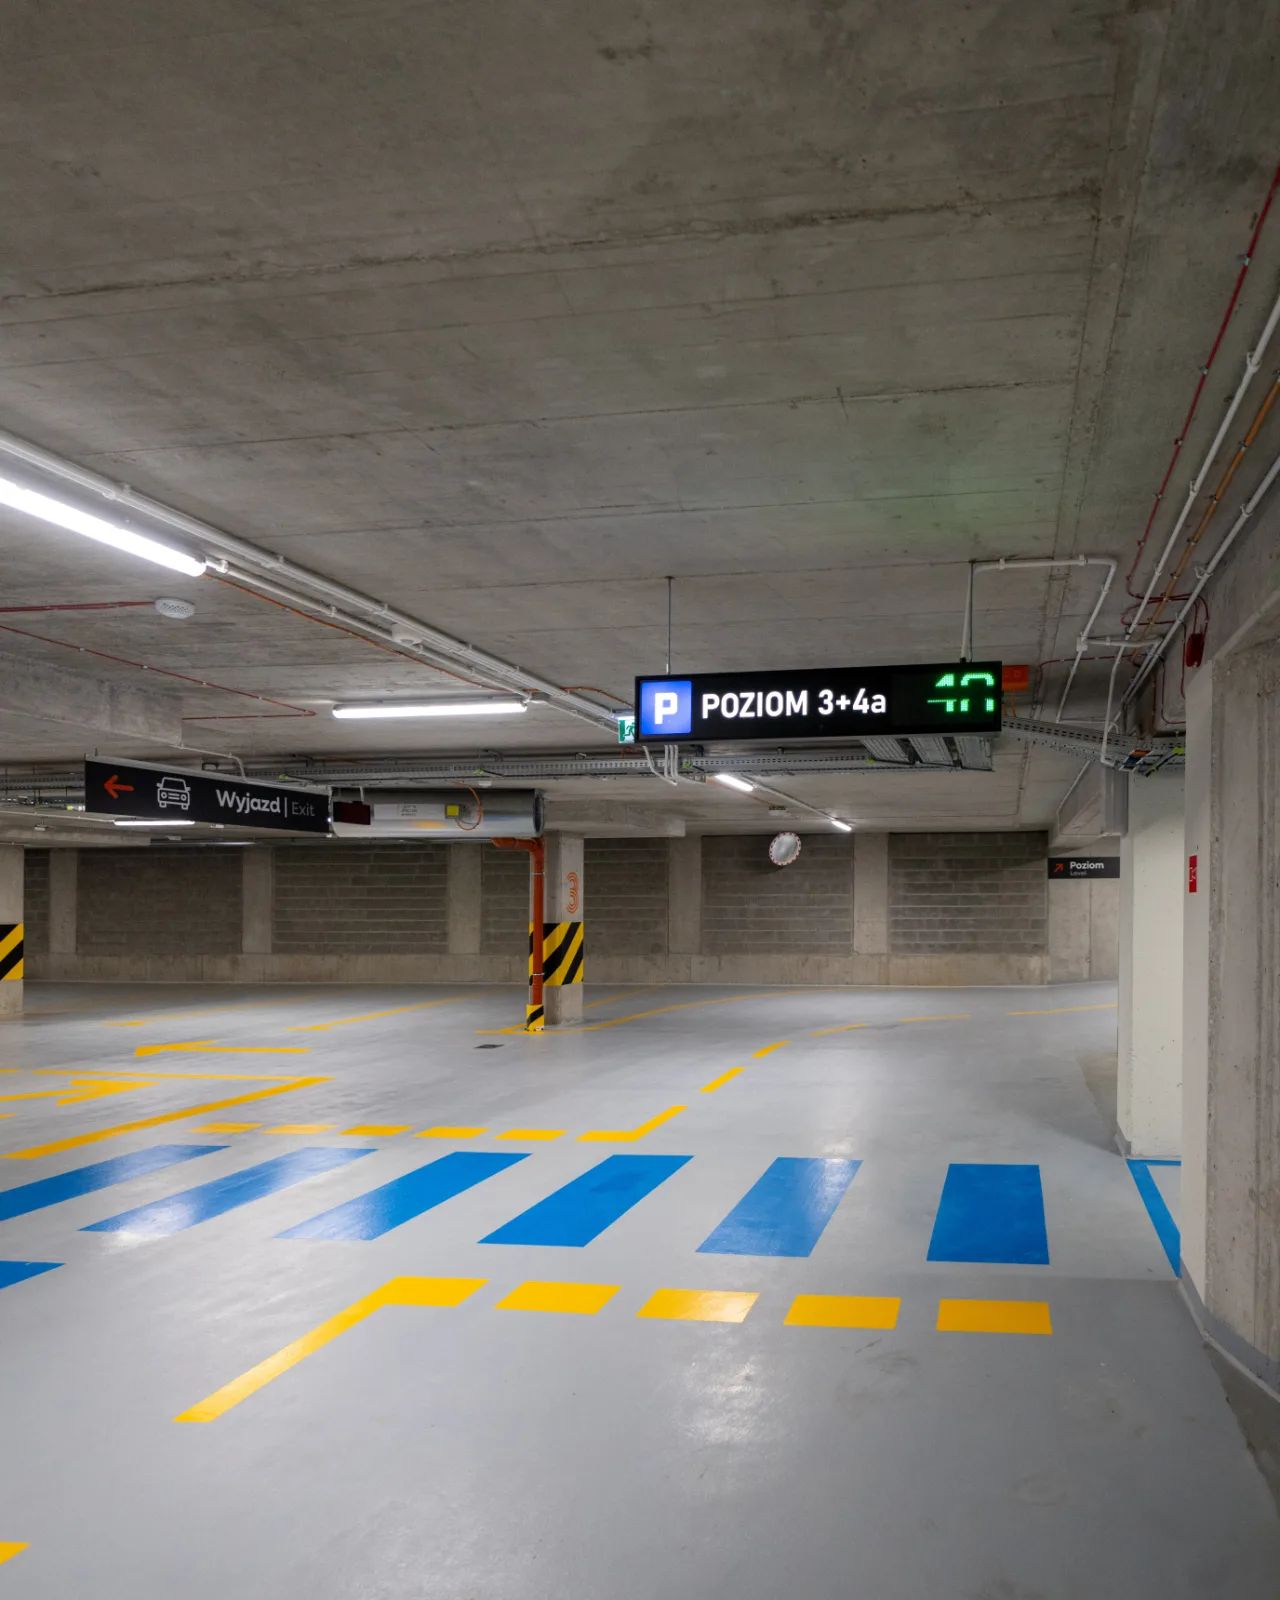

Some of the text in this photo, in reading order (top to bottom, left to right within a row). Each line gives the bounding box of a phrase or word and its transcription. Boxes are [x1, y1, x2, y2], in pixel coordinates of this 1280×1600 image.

[654, 692, 678, 725] P
[701, 688, 887, 720] POZIOM 3+4a
[215, 789, 316, 817] Wyjazd Exit
[1070, 861, 1104, 870] Poziom
